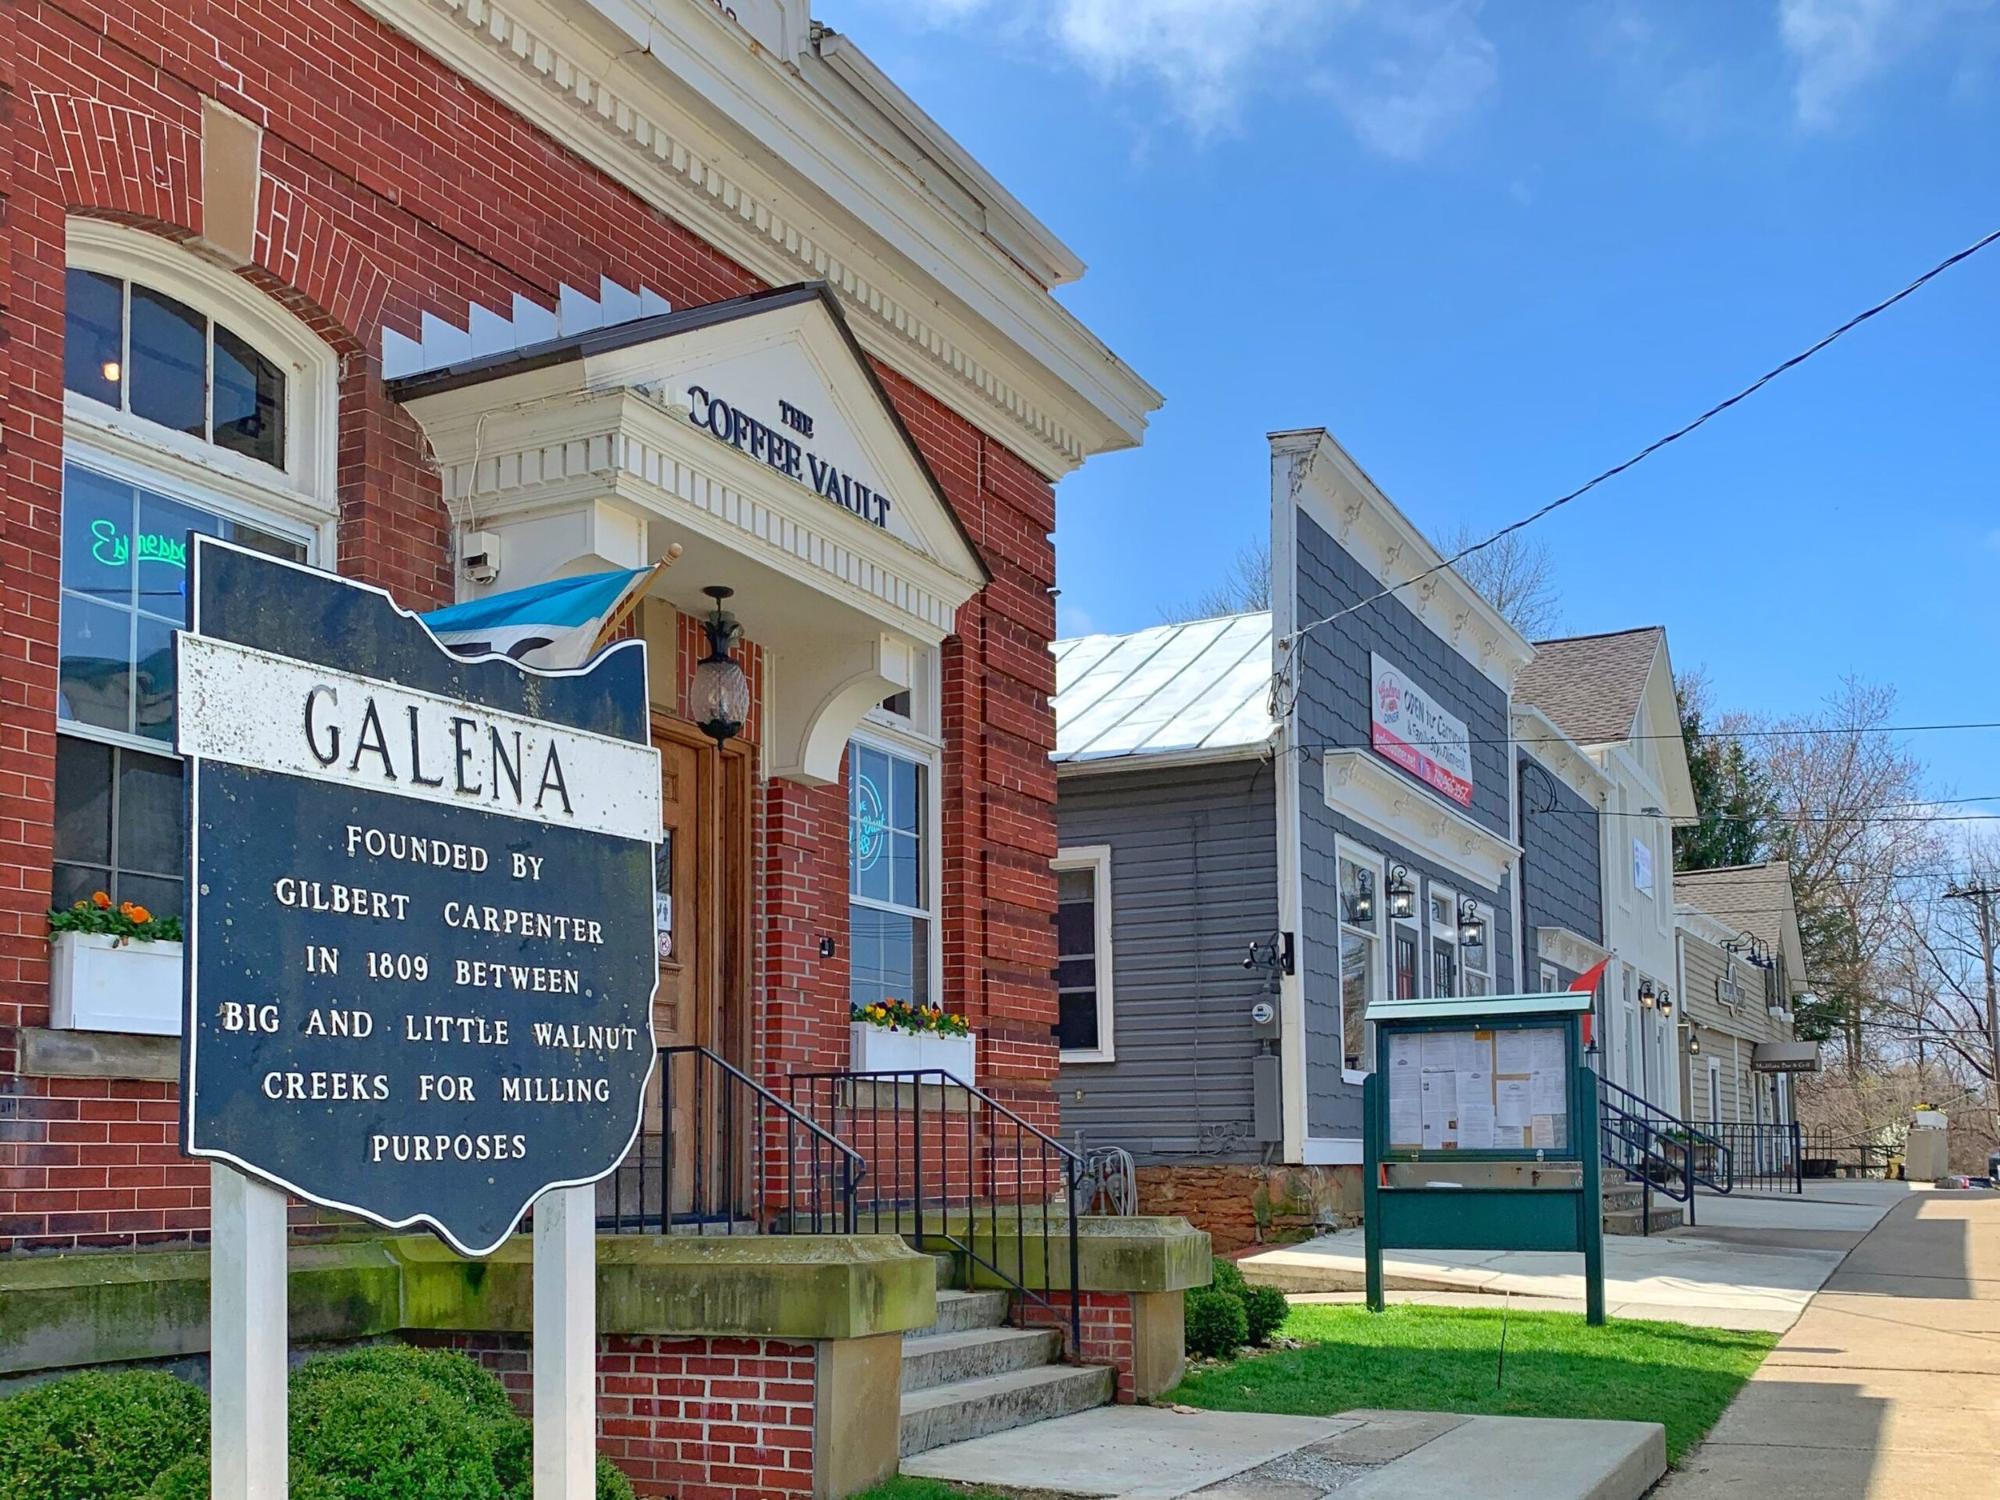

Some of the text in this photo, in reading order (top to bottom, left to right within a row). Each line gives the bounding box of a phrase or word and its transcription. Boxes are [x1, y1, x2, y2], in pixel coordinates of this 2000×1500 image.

[779, 400, 814, 439] THE
[687, 386, 890, 528] COFFEE VAULT
[1403, 690, 1425, 724] OPEN
[304, 684, 574, 815] GALENA
[346, 825, 544, 881] FOUNDED BY
[275, 878, 604, 945] GILBERT CARPENTER
[306, 946, 579, 995] IN 1809 BETWEEN
[223, 1002, 638, 1051] BIG AND LITTLE WALNUT
[263, 1071, 610, 1103] CREEKS FOR MILLING
[372, 1134, 527, 1163] PURPOSES
